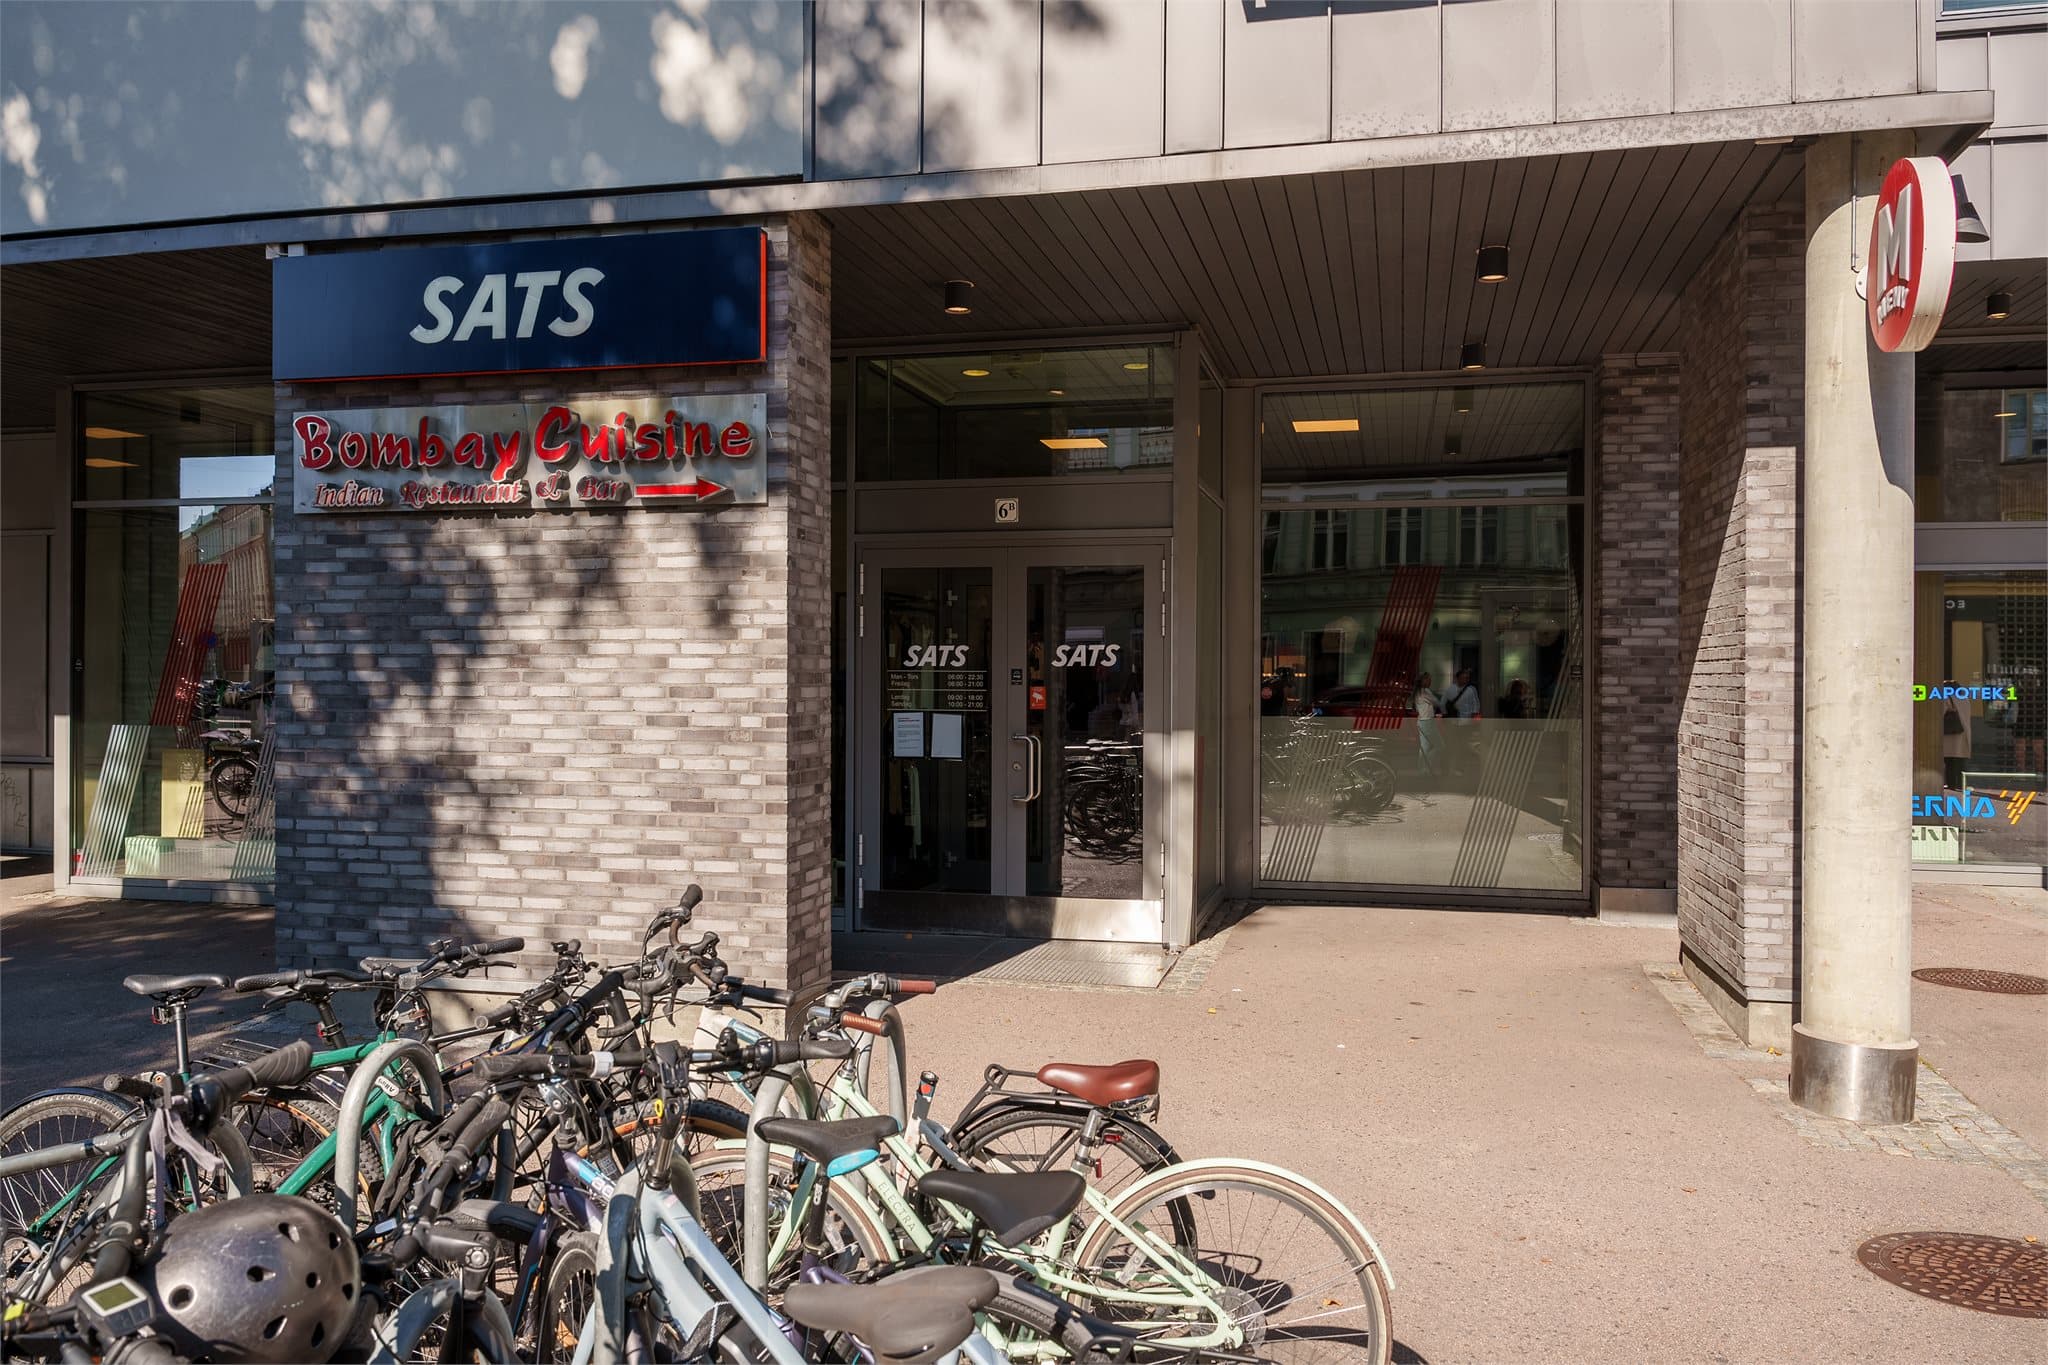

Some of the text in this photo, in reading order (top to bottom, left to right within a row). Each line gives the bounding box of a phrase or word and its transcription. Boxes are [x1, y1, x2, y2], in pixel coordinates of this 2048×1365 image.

[409, 267, 606, 344] SATS
[293, 406, 755, 482] Bombay Cuisine
[312, 471, 623, 507] Indian Restaurant & Bar
[903, 645, 970, 667] SATS
[1051, 644, 1121, 668] SATS
[878, 1182, 916, 1232] ELECTRA
